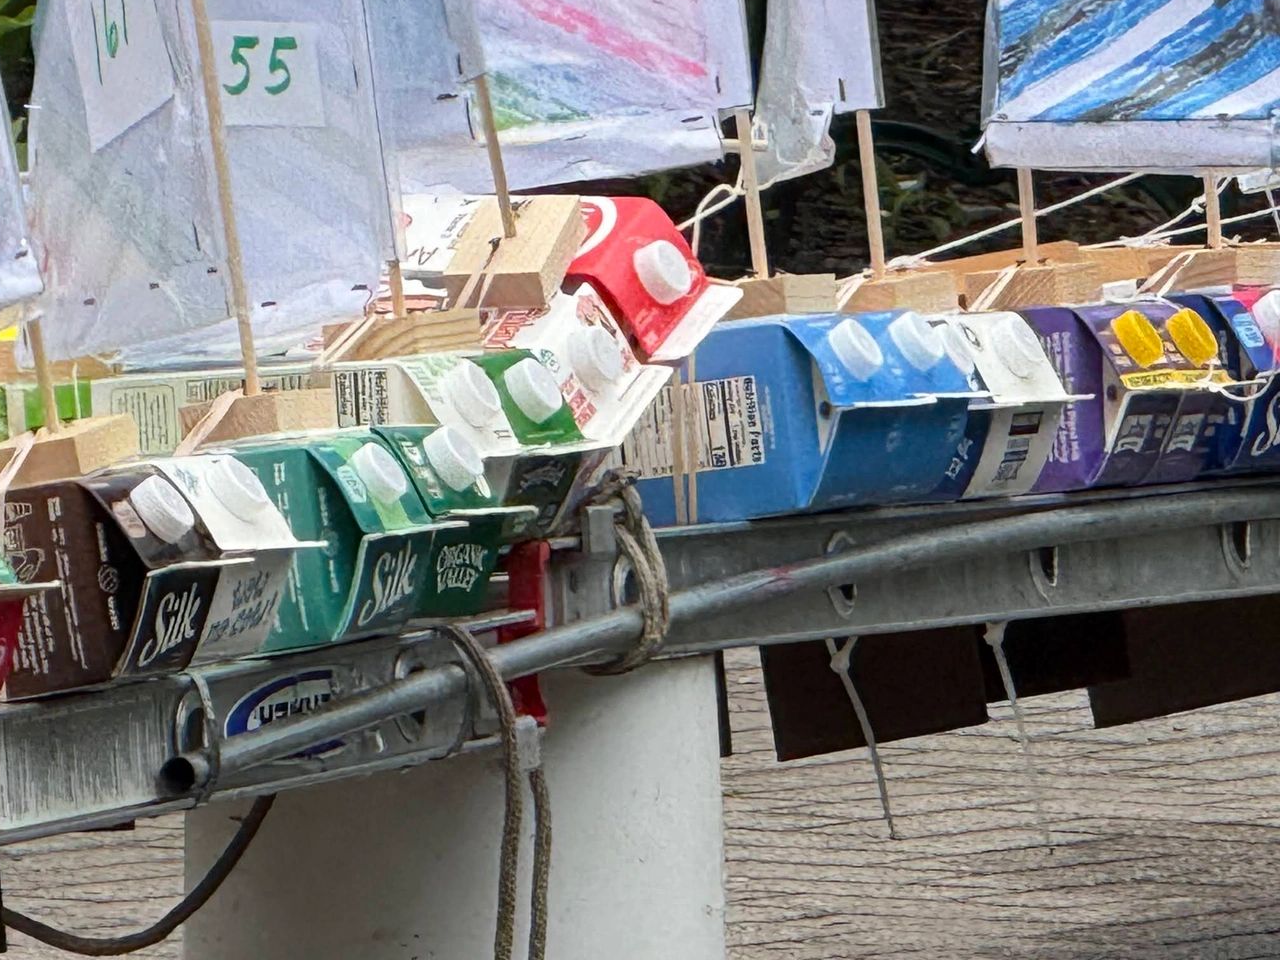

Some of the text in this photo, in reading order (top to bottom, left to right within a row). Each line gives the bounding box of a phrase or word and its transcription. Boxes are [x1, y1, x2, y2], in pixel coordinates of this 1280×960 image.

[222, 35, 298, 97] 55
[138, 582, 202, 668] Silk
[358, 540, 418, 627] Silk
